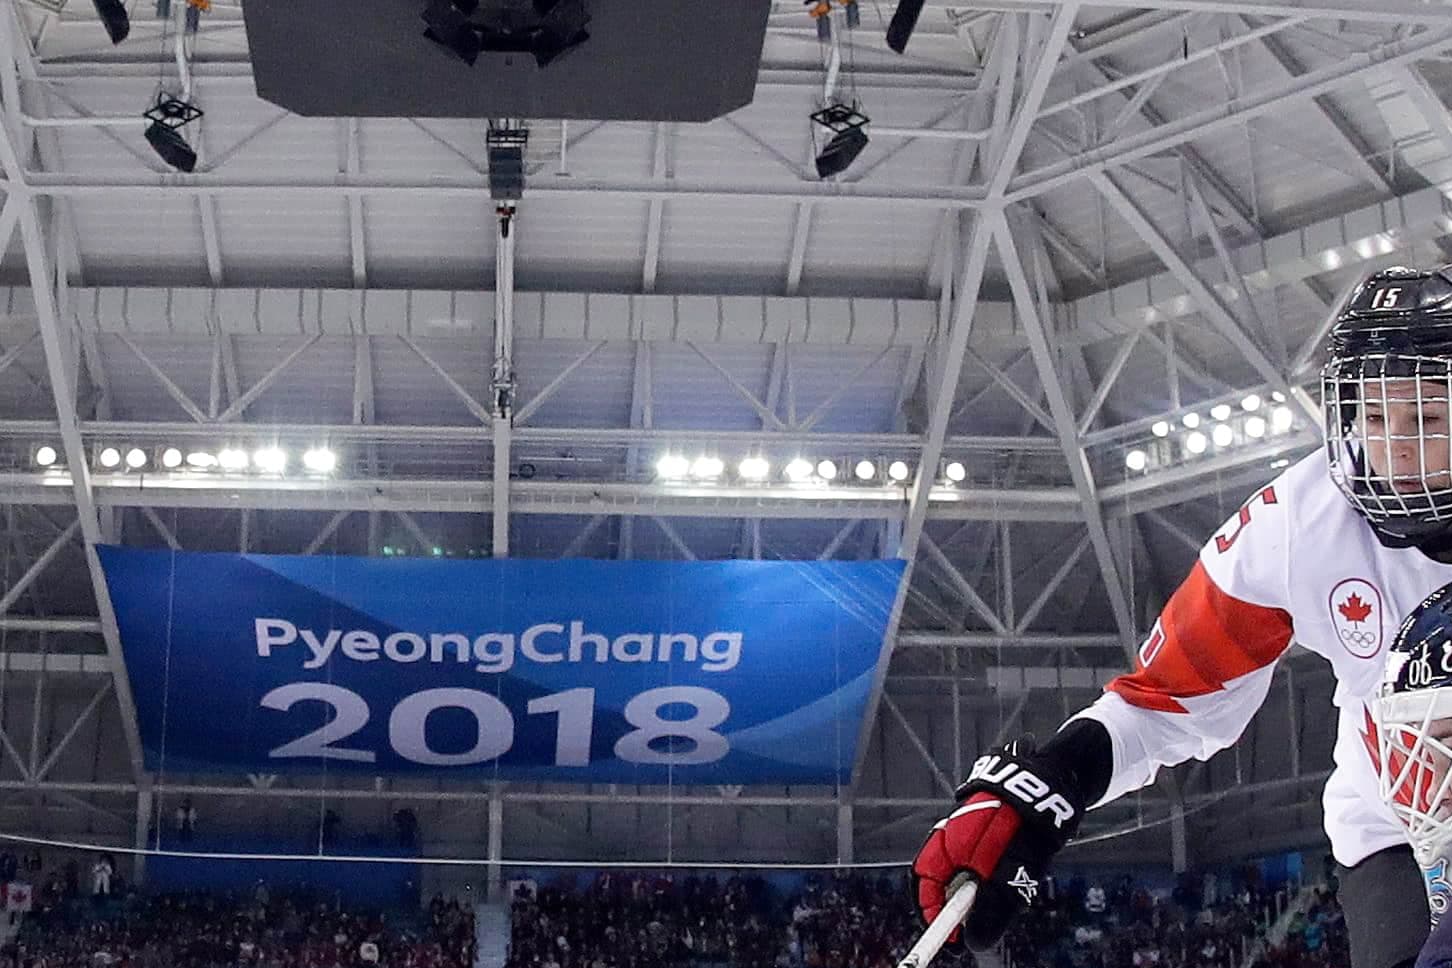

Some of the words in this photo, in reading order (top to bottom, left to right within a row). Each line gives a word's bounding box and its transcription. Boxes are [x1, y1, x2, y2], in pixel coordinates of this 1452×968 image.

[1370, 287, 1402, 309] 15
[254, 617, 744, 673] PyeongChang
[259, 681, 732, 768] 2018
